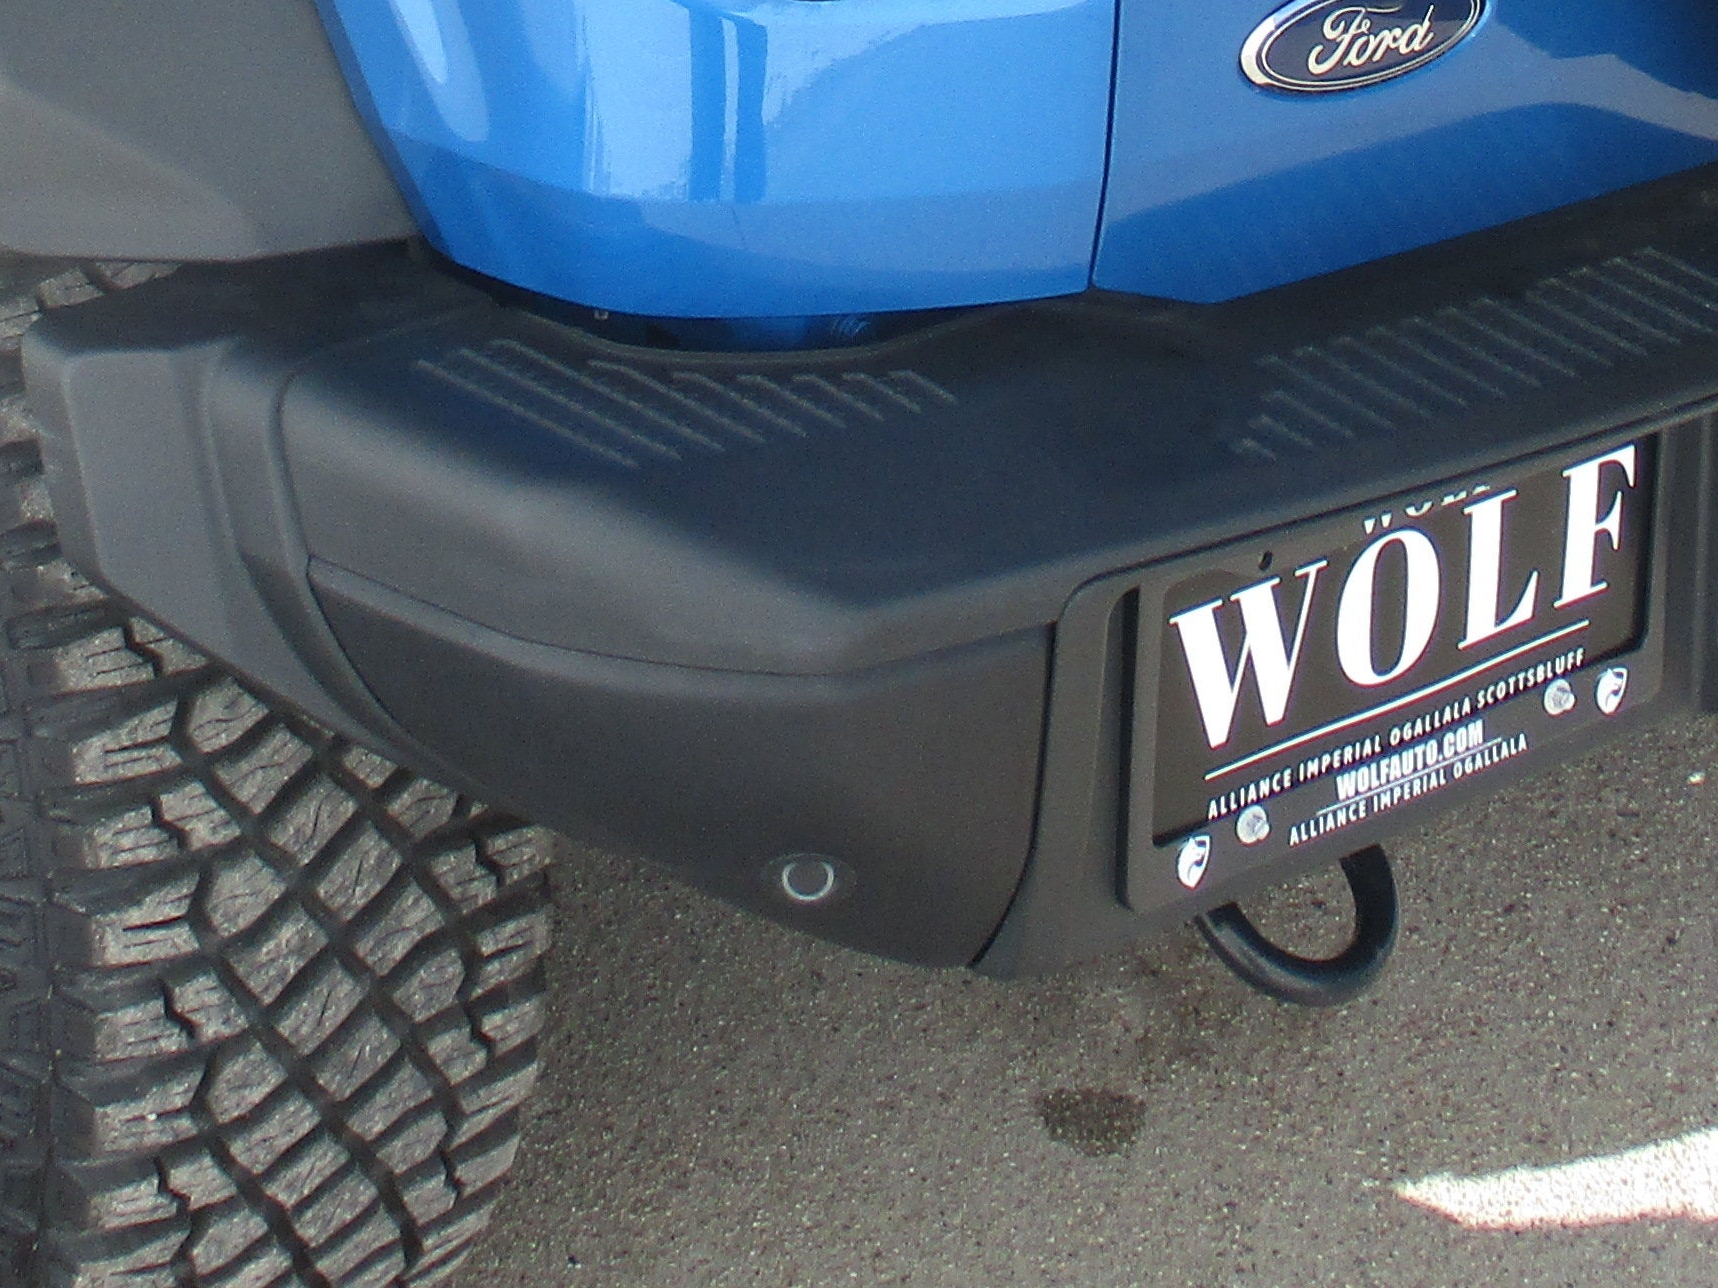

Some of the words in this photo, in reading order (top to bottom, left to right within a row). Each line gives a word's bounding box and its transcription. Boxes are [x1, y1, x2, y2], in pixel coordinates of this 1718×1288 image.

[1306, 4, 1434, 75] Ford
[1169, 444, 1637, 749] WOLF
[1208, 767, 1293, 820] ALLIANCE
[1298, 735, 1382, 783] IMPERIAL
[1389, 695, 1473, 747] OGALLALA
[1476, 647, 1585, 710] SCOTTSBLUFF
[1288, 801, 1368, 847] ALLIANCE
[1373, 772, 1447, 813] IMPERIAL
[1452, 732, 1529, 779] OGALLALA
[1336, 718, 1485, 801] WOLFAUTO.COM
